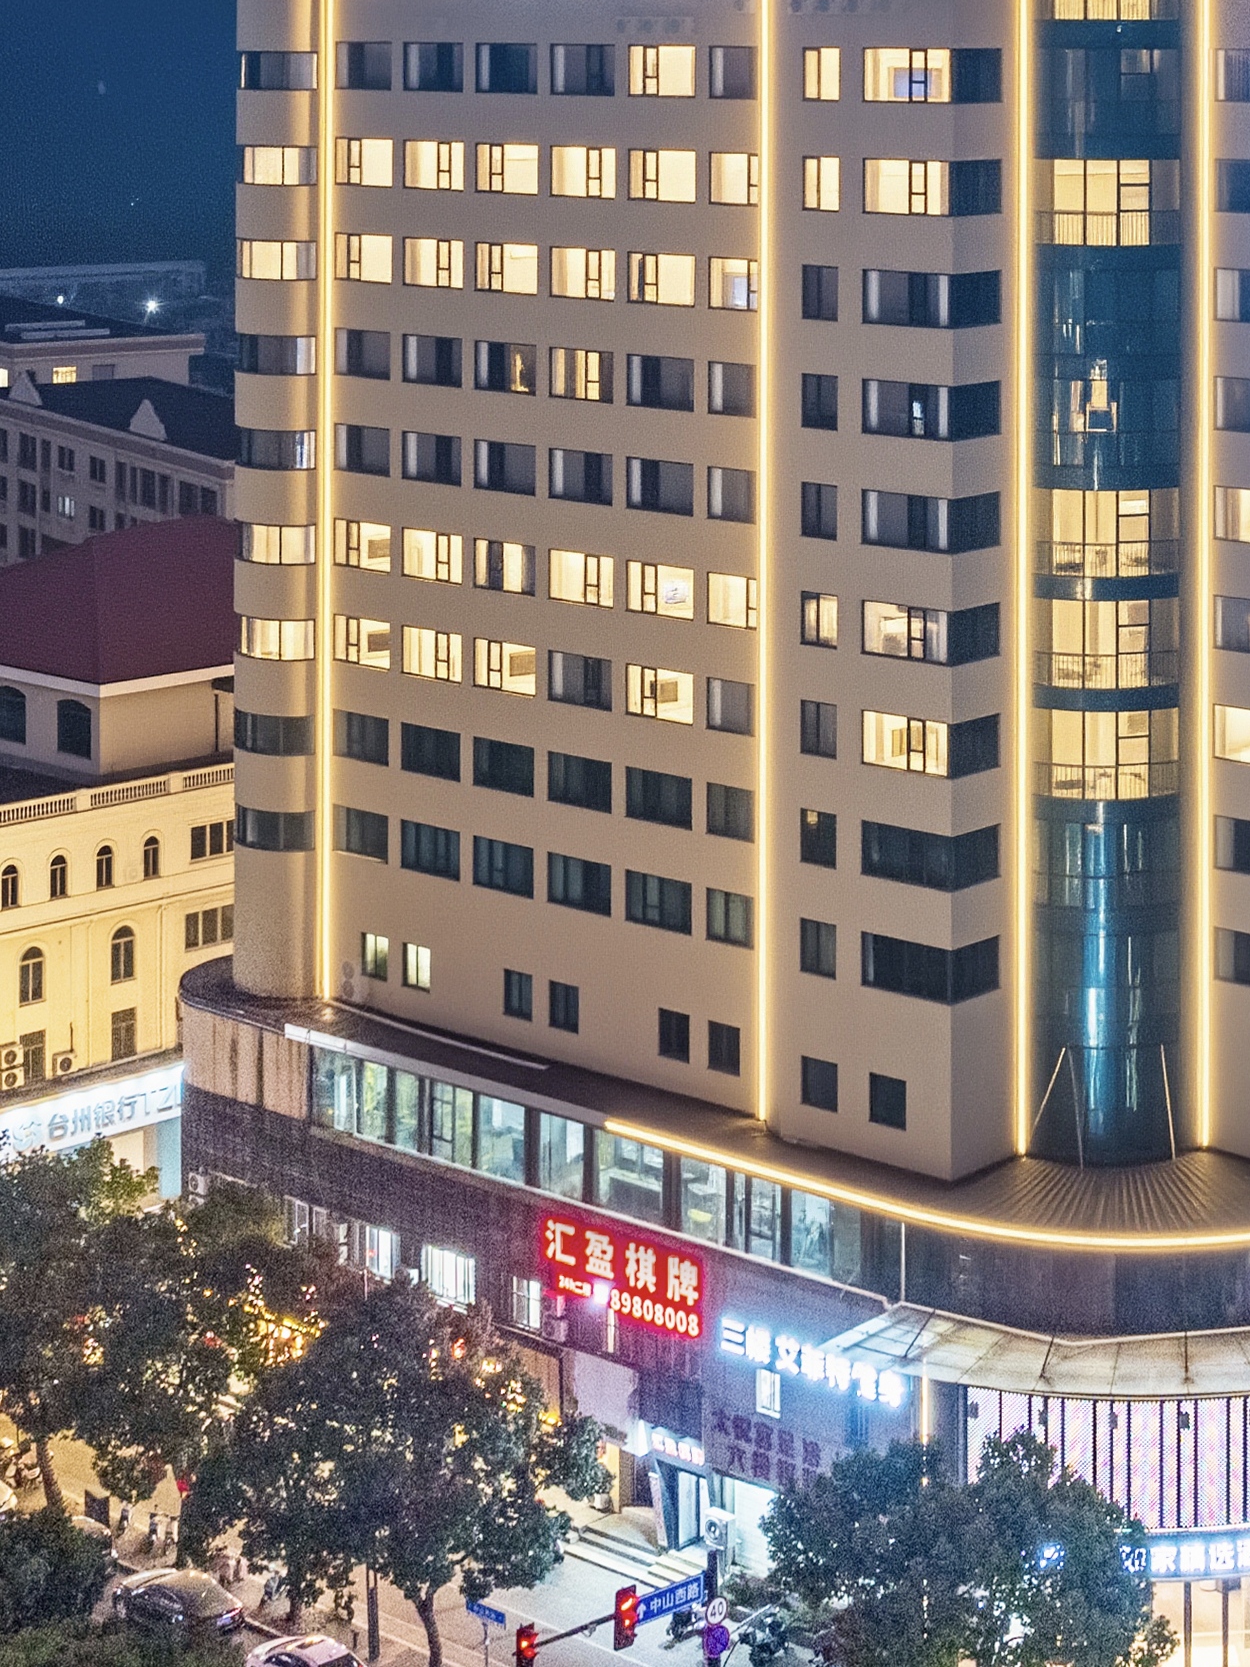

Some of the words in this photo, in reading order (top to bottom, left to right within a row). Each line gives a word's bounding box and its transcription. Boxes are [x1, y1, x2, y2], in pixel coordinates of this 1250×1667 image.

[47, 1094, 138, 1141] 台州银行
[545, 1219, 699, 1306] 汇盈棋牌
[610, 1288, 699, 1337] 89808008
[650, 1583, 700, 1614] 中山西路
[710, 1601, 724, 1618] 40
